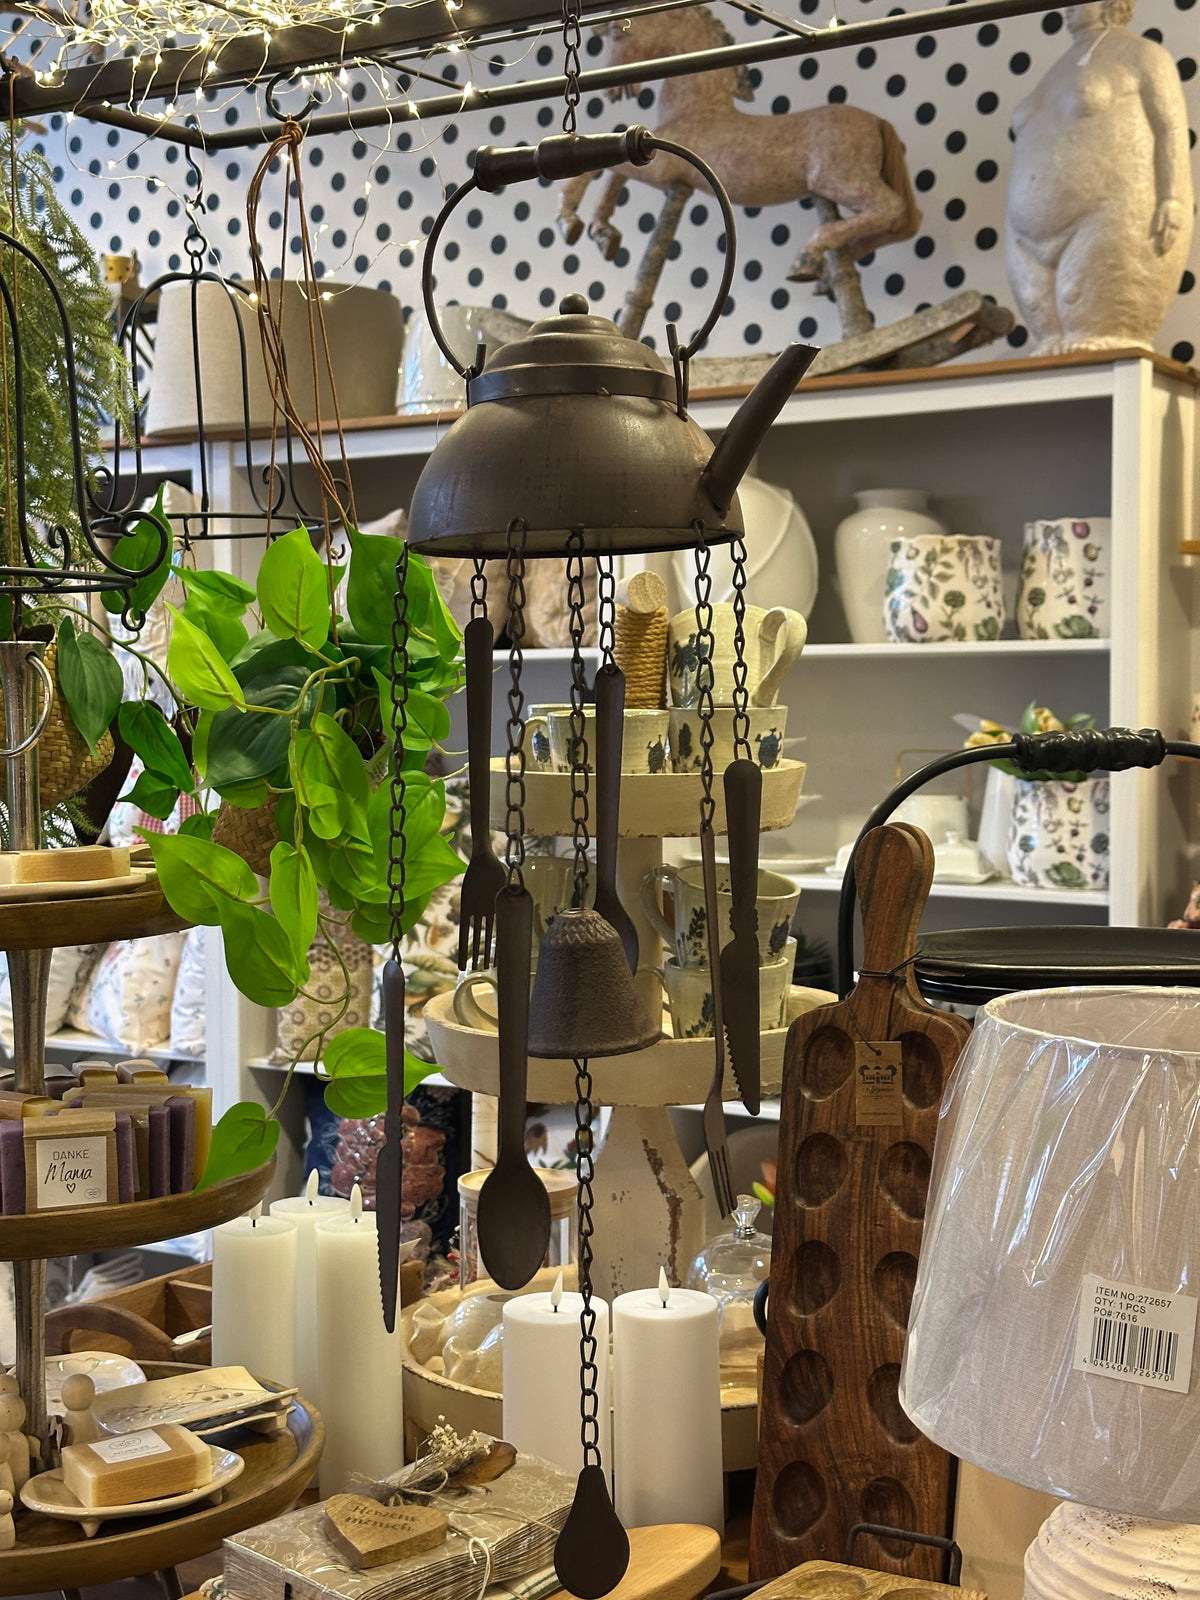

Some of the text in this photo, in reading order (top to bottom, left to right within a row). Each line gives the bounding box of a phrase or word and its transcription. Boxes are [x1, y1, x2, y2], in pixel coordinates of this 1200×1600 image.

[53, 1149, 89, 1160] DANKE
[44, 1161, 92, 1184] Mama
[1095, 1286, 1118, 1298] ITEM
[1094, 1296, 1116, 1309] QTY:
[1126, 1303, 1146, 1314] PCS
